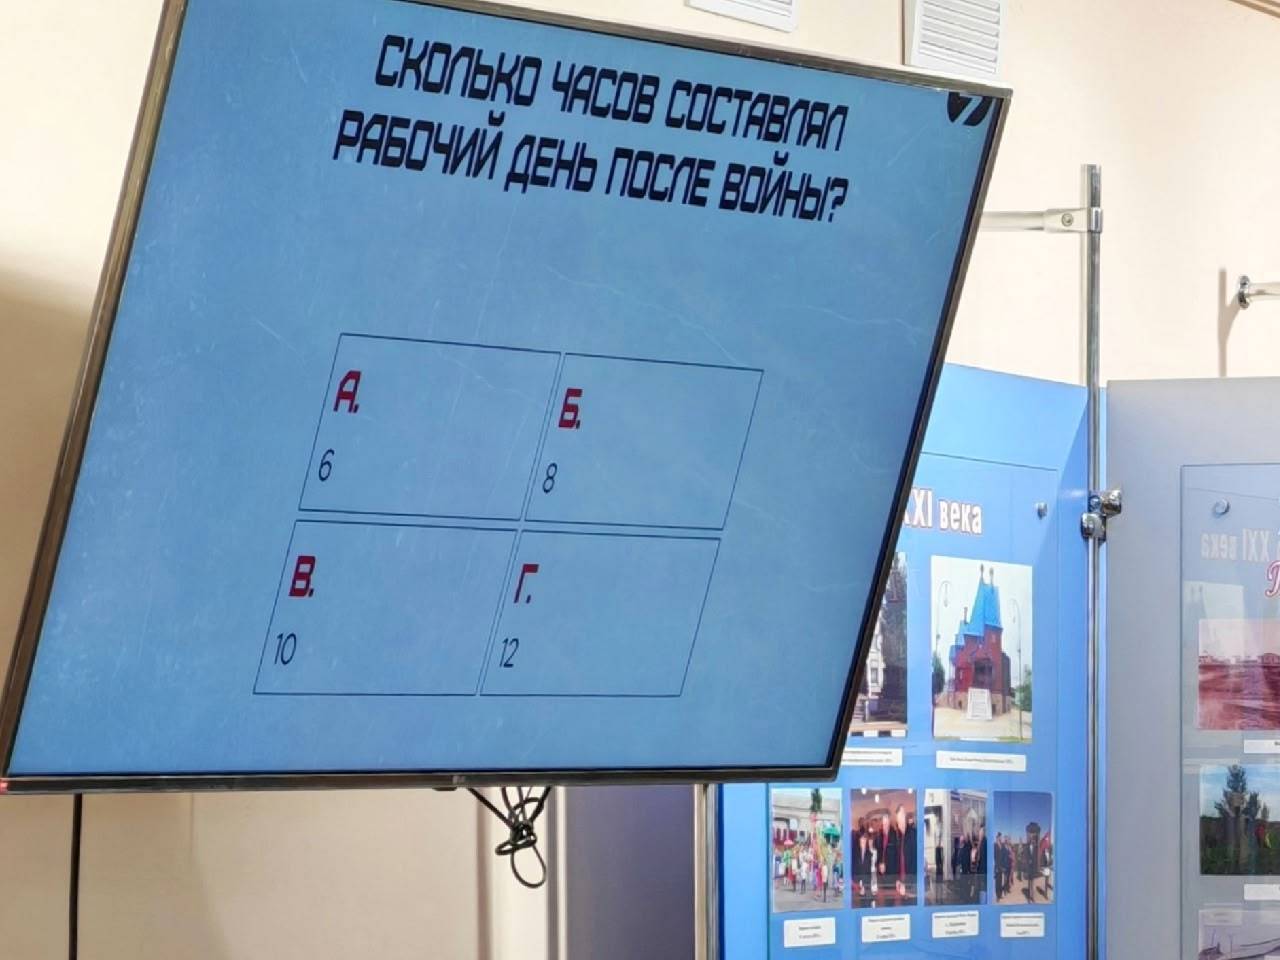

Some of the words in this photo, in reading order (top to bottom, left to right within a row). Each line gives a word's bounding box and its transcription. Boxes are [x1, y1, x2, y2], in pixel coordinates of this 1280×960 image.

[375, 33, 543, 107] СКОЛЬКО
[551, 59, 660, 126] ЧАСОВ
[664, 79, 849, 152] СОСТАВЛЯЛ
[333, 109, 505, 181] РАБОЧИЙ
[503, 133, 599, 194] ДЕНЬ
[605, 146, 716, 208] ПОСЛЕ
[717, 151, 850, 223] ВОЙНЫ?
[333, 370, 362, 413] А.
[558, 388, 583, 430] Б.
[318, 448, 335, 482] 6
[542, 463, 558, 494] 8
[938, 498, 983, 535] века
[288, 555, 316, 598] В.
[513, 563, 540, 604] Г.
[274, 633, 297, 665] 10
[499, 638, 520, 668] 12
